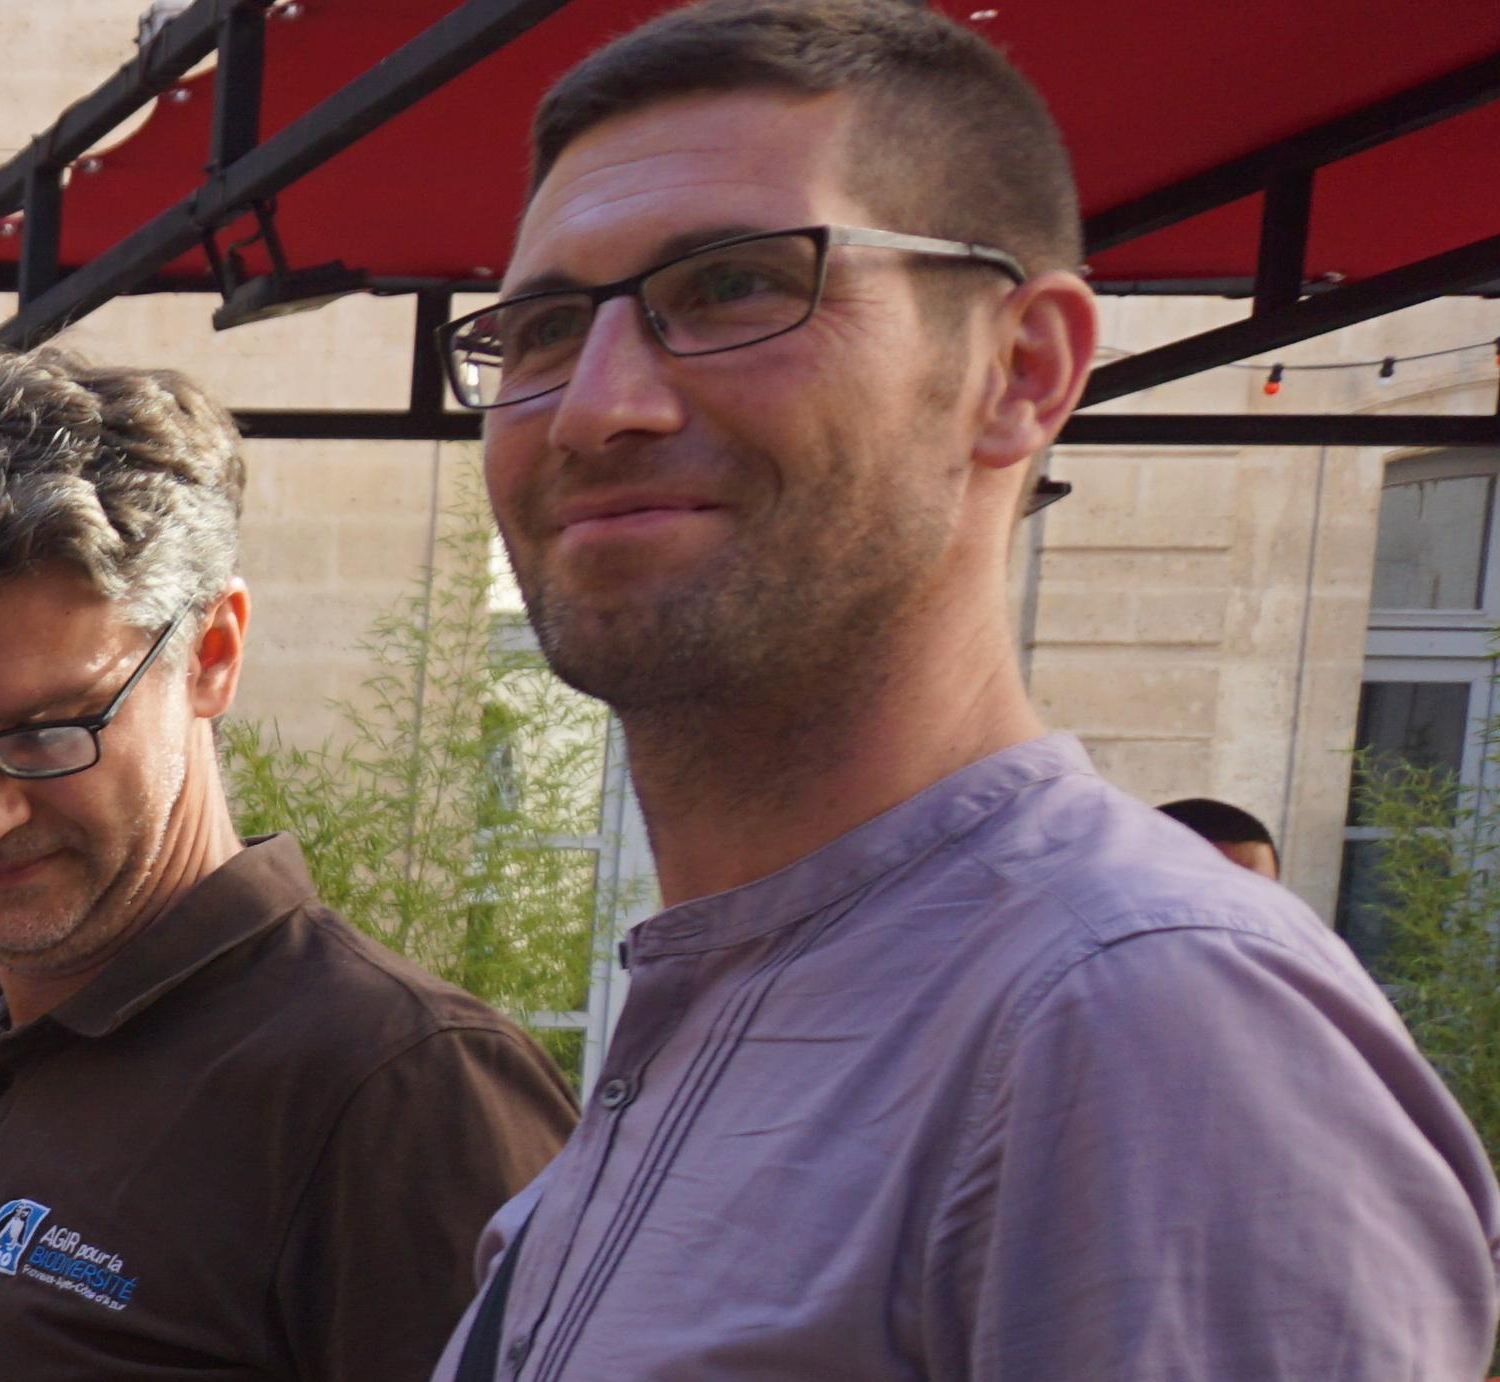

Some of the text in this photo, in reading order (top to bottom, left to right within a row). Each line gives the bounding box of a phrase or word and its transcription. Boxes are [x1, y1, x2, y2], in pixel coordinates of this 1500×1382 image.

[28, 1244, 137, 1301] BIODIVERSITÉ
[40, 1225, 123, 1273] AGIR pour la
